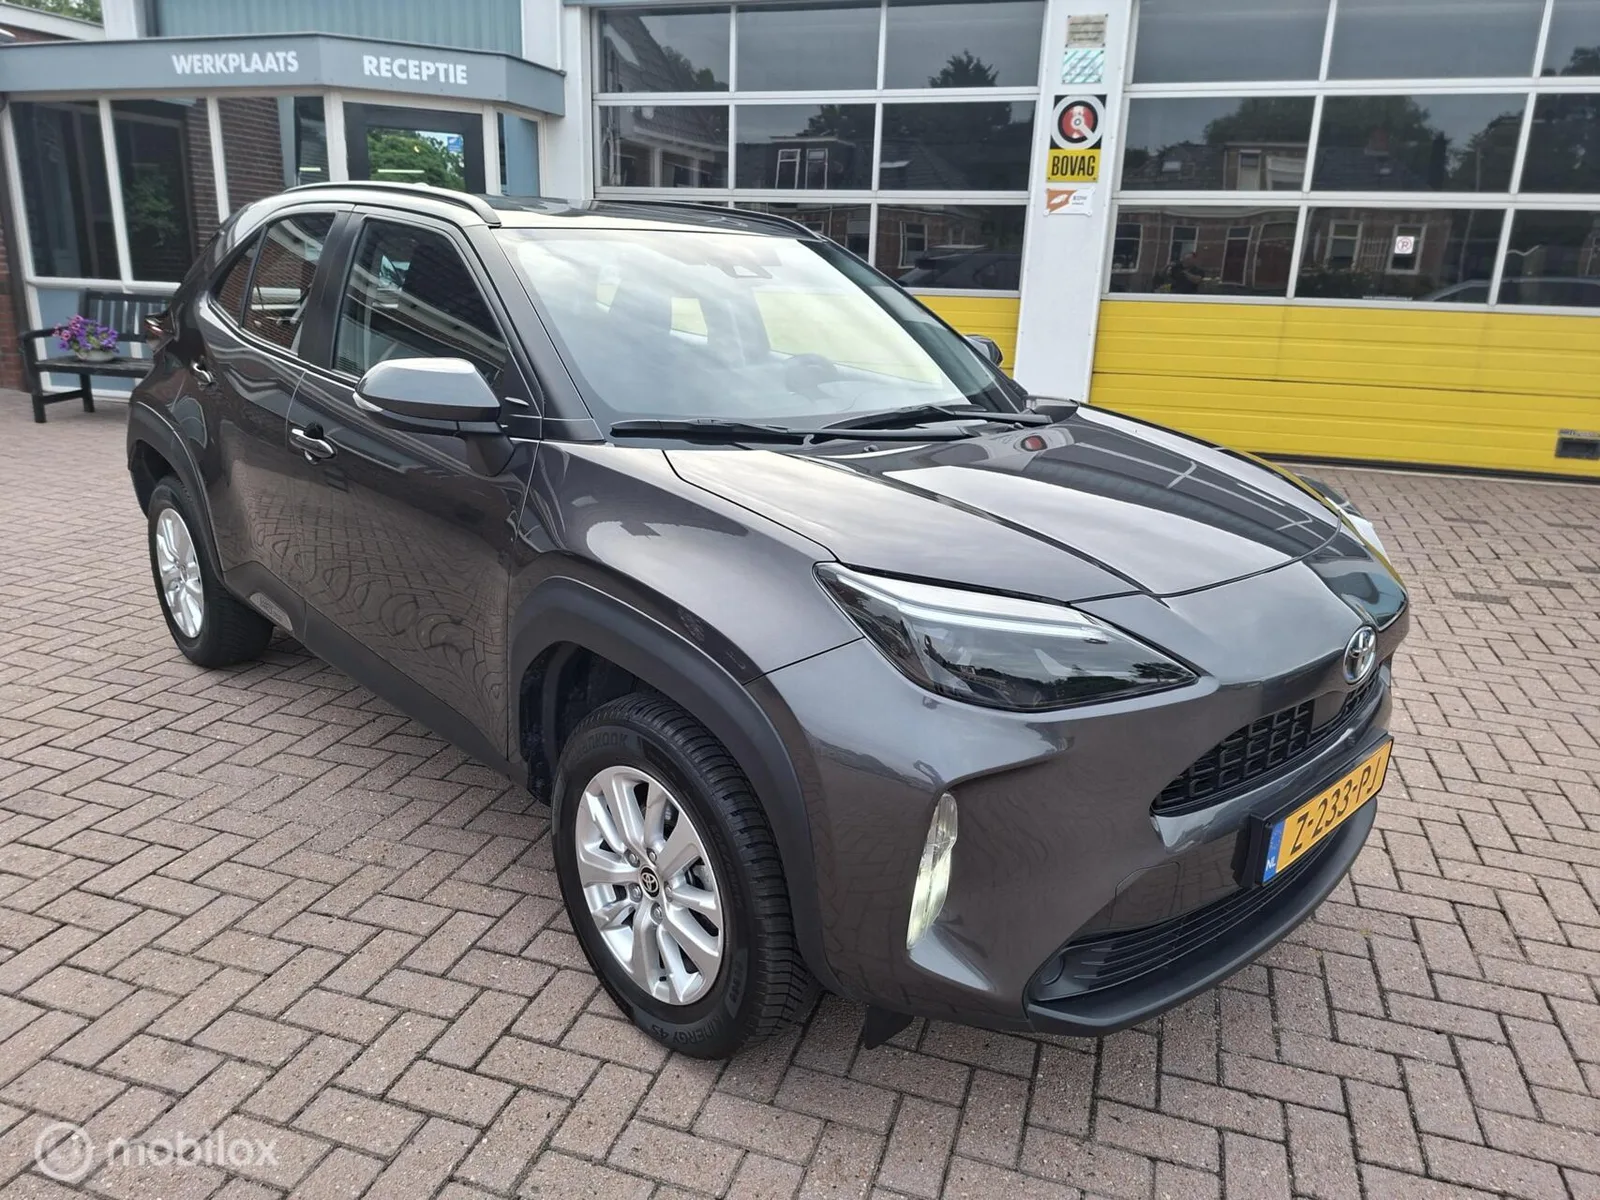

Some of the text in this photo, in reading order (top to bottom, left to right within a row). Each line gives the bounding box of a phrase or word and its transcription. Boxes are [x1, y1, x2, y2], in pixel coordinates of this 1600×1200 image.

[171, 50, 299, 75] WERKPLAATS
[362, 54, 468, 85] RECEPTIE
[1051, 154, 1096, 177] BOVAG
[1290, 755, 1382, 856] Z-233-PJ
[1265, 855, 1276, 871] NL
